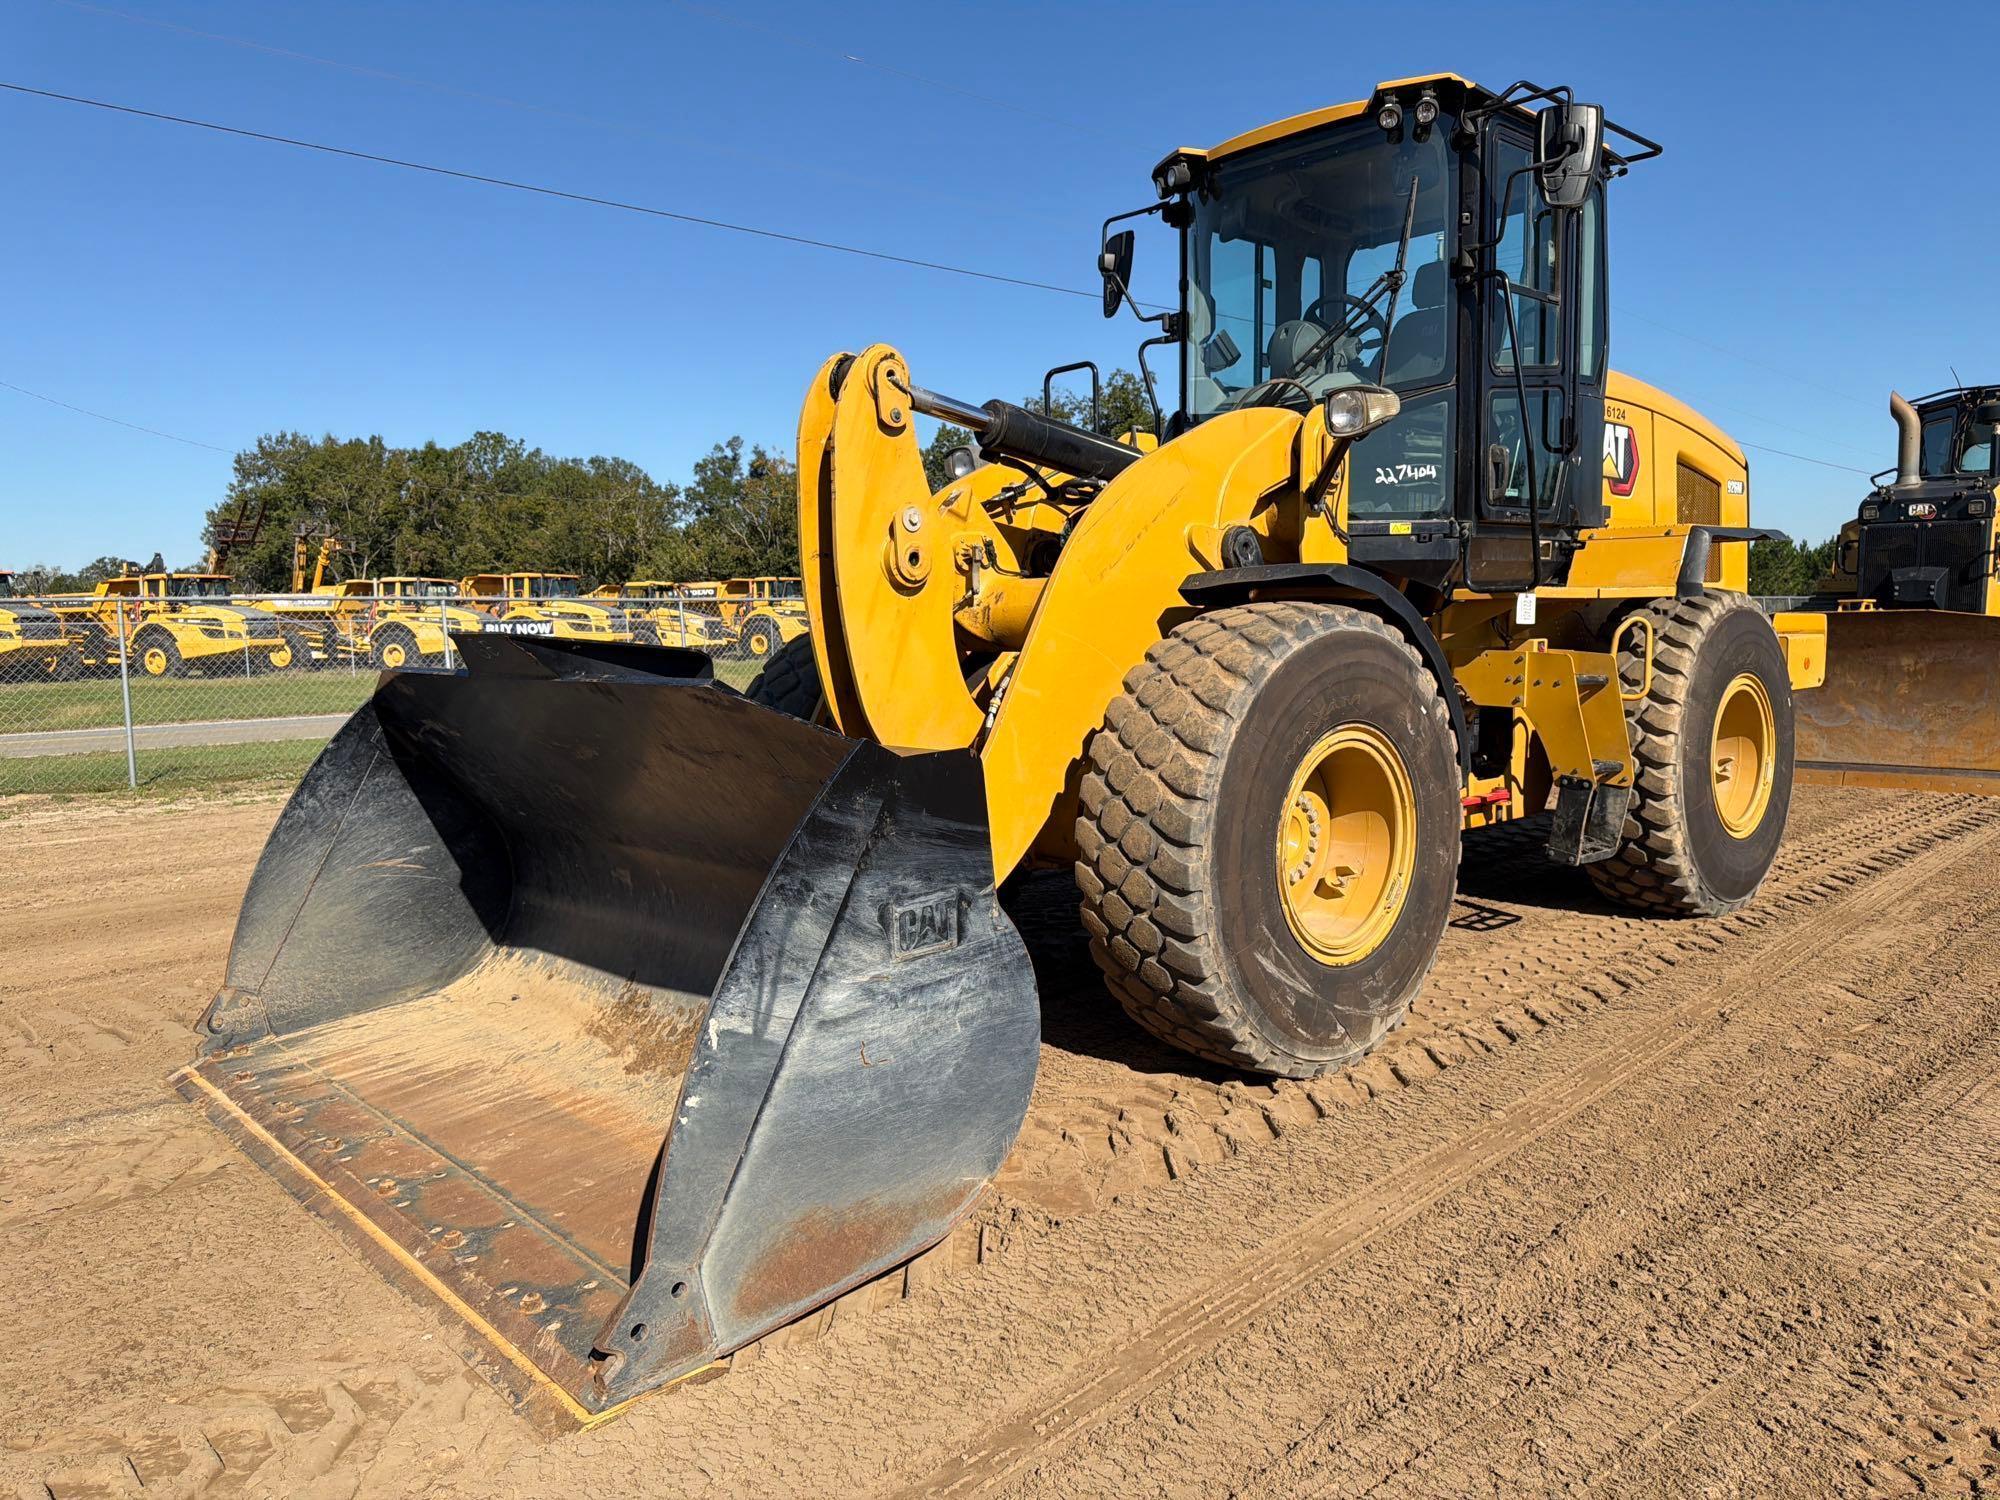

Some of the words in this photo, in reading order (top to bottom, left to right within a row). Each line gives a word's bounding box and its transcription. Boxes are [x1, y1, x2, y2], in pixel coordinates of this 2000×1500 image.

[1602, 423, 1629, 479] AT
[1375, 464, 1437, 484] 227404
[1909, 503, 1930, 516] CAT
[515, 622, 552, 635] NOW
[899, 901, 955, 951] CAT
